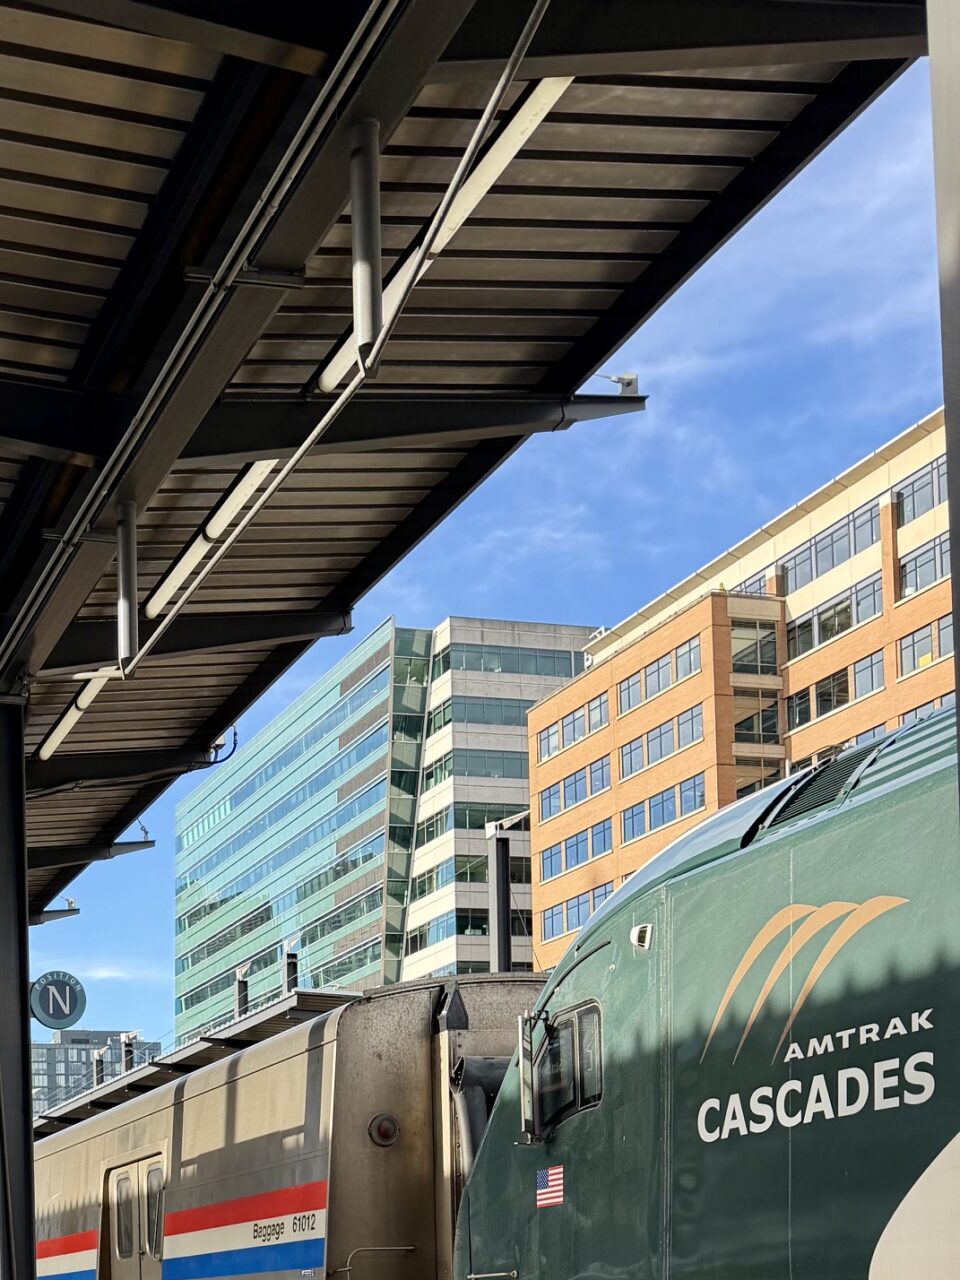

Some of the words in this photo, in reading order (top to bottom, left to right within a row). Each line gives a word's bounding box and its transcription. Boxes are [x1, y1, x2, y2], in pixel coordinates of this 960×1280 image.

[35, 972, 83, 991] POSITION
[47, 985, 70, 1014] N
[783, 1008, 934, 1063] AMTRAK
[697, 1051, 936, 1143] CASCADES
[253, 1222, 285, 1242] Baggage
[292, 1213, 316, 1233] 61012
